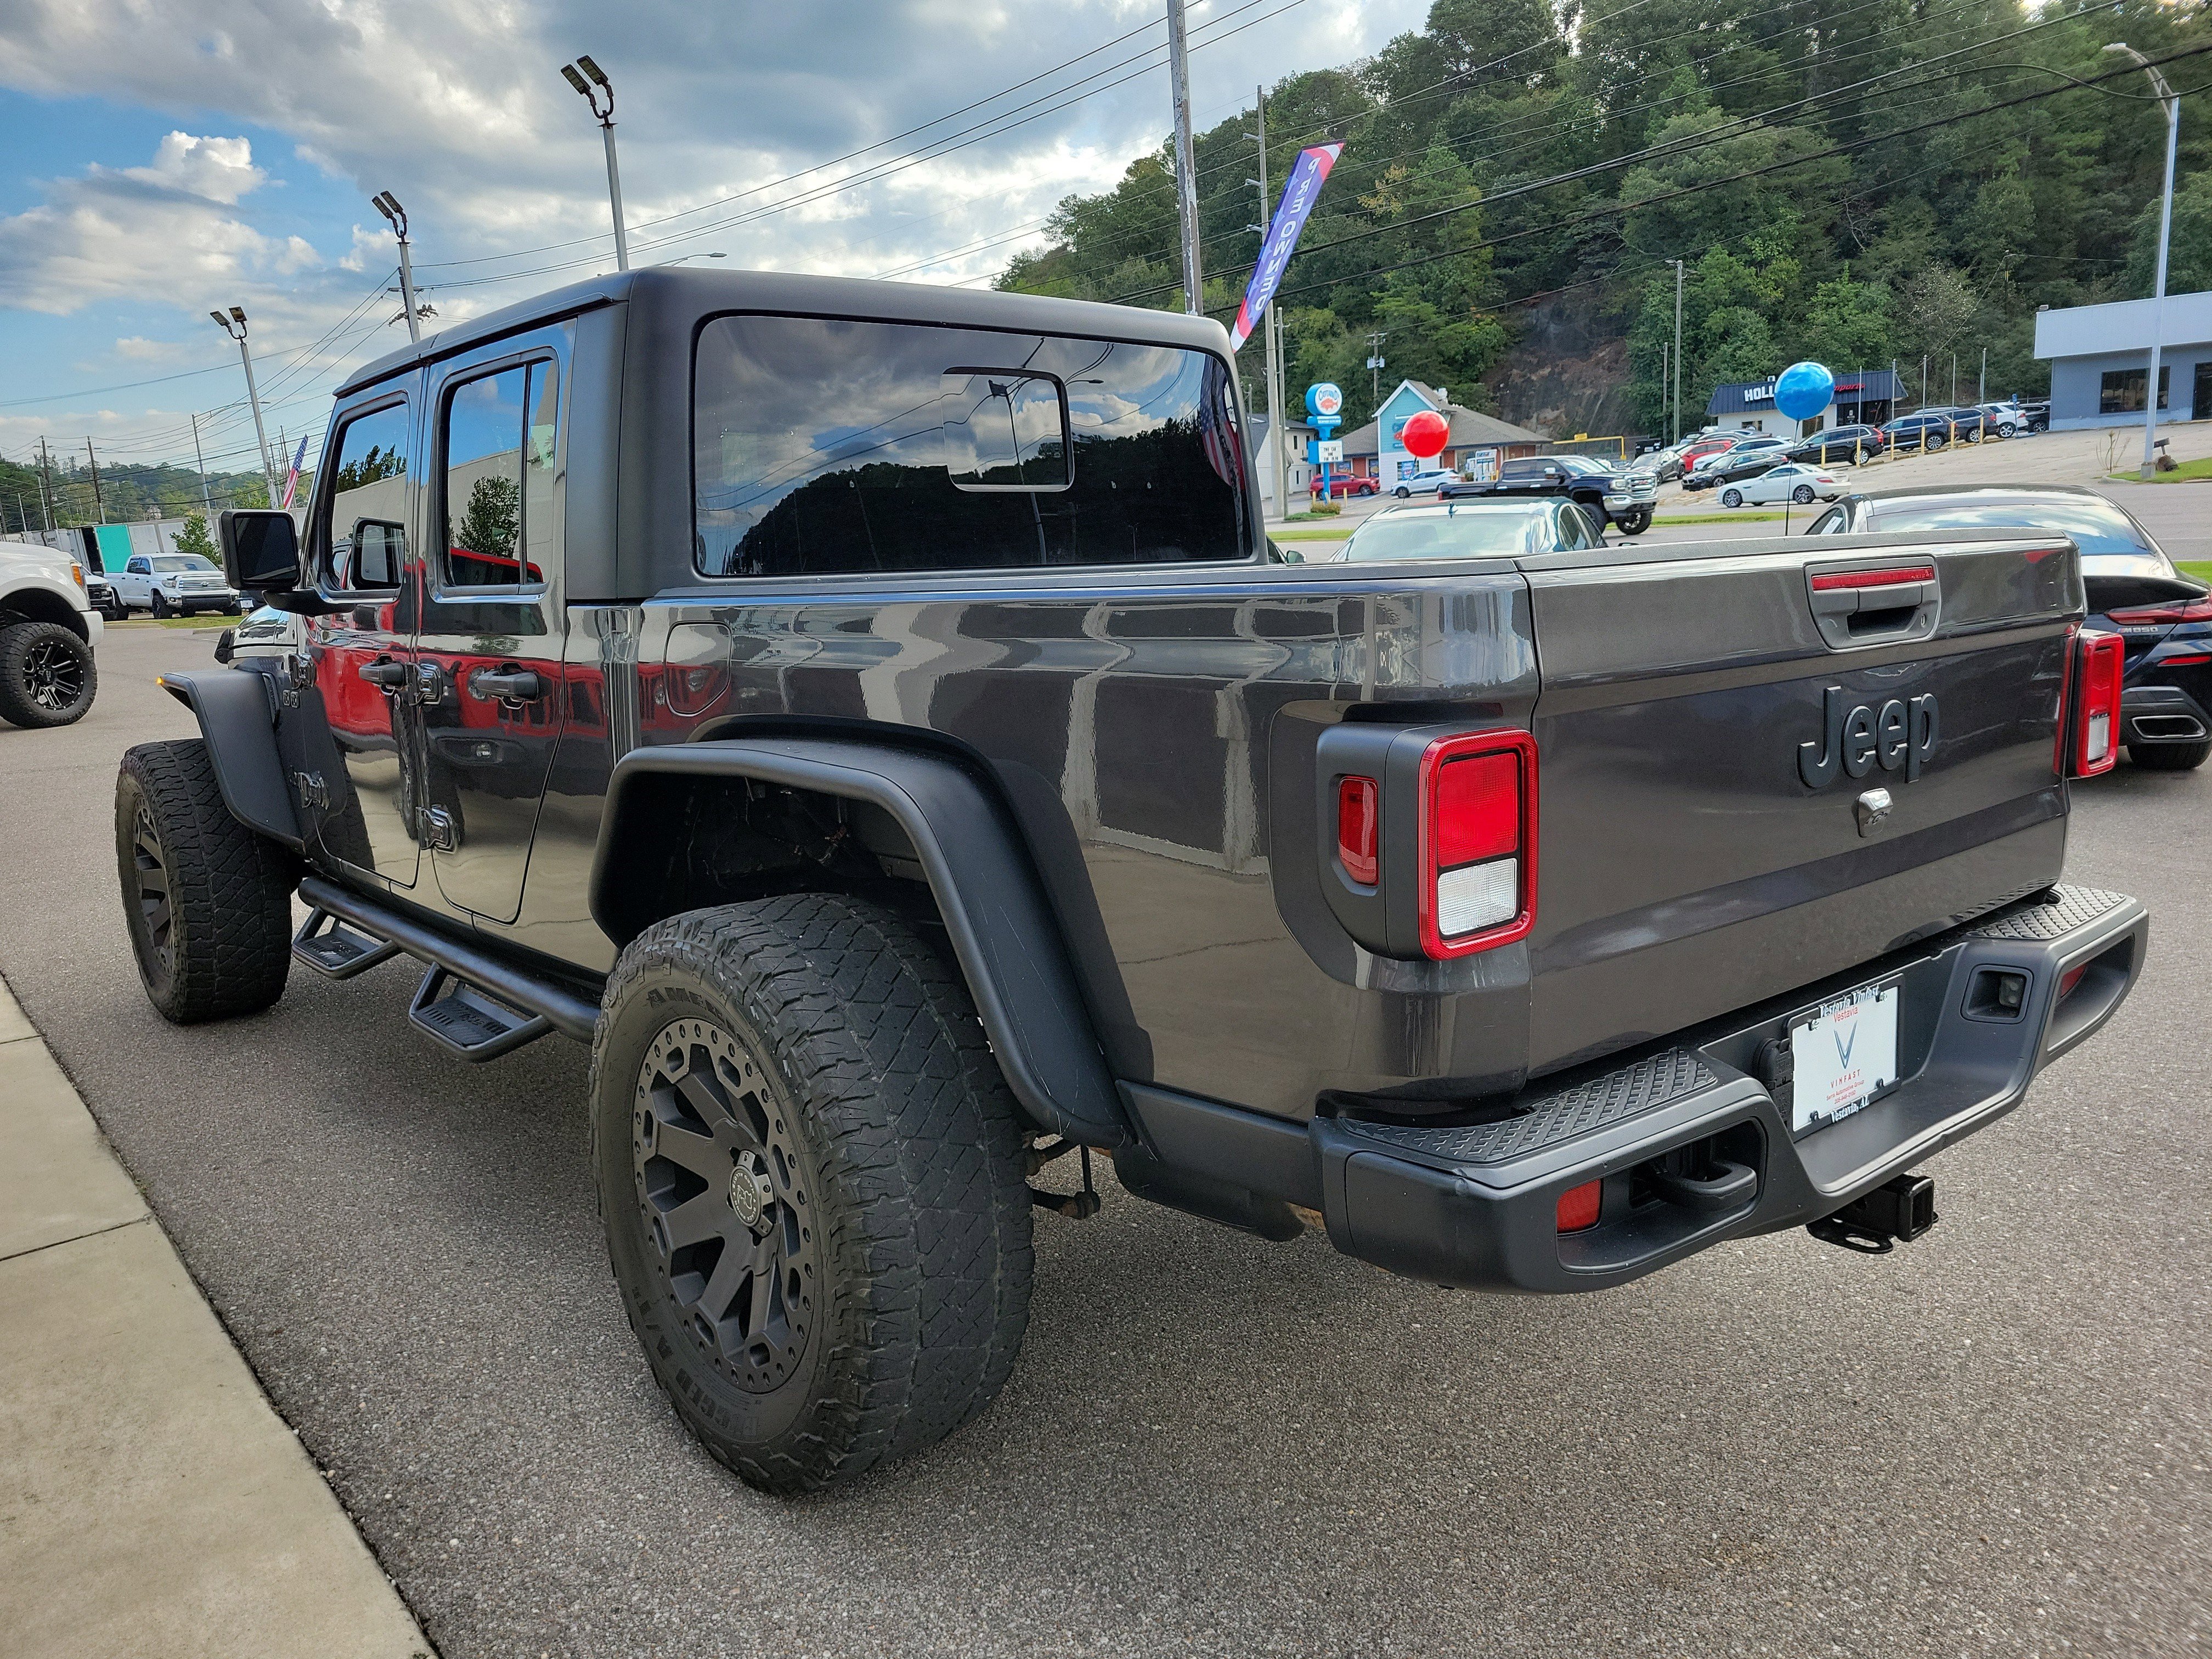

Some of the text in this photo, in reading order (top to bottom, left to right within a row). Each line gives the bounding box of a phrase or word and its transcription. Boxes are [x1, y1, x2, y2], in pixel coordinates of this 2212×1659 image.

[1797, 685, 1939, 788] Jeep
[1818, 984, 1880, 1018] Vestavia Vinfast
[1833, 1006, 1858, 1023] Vestavia
[1830, 1069, 1860, 1088] VINFAST
[1859, 1094, 1870, 1109] AL
